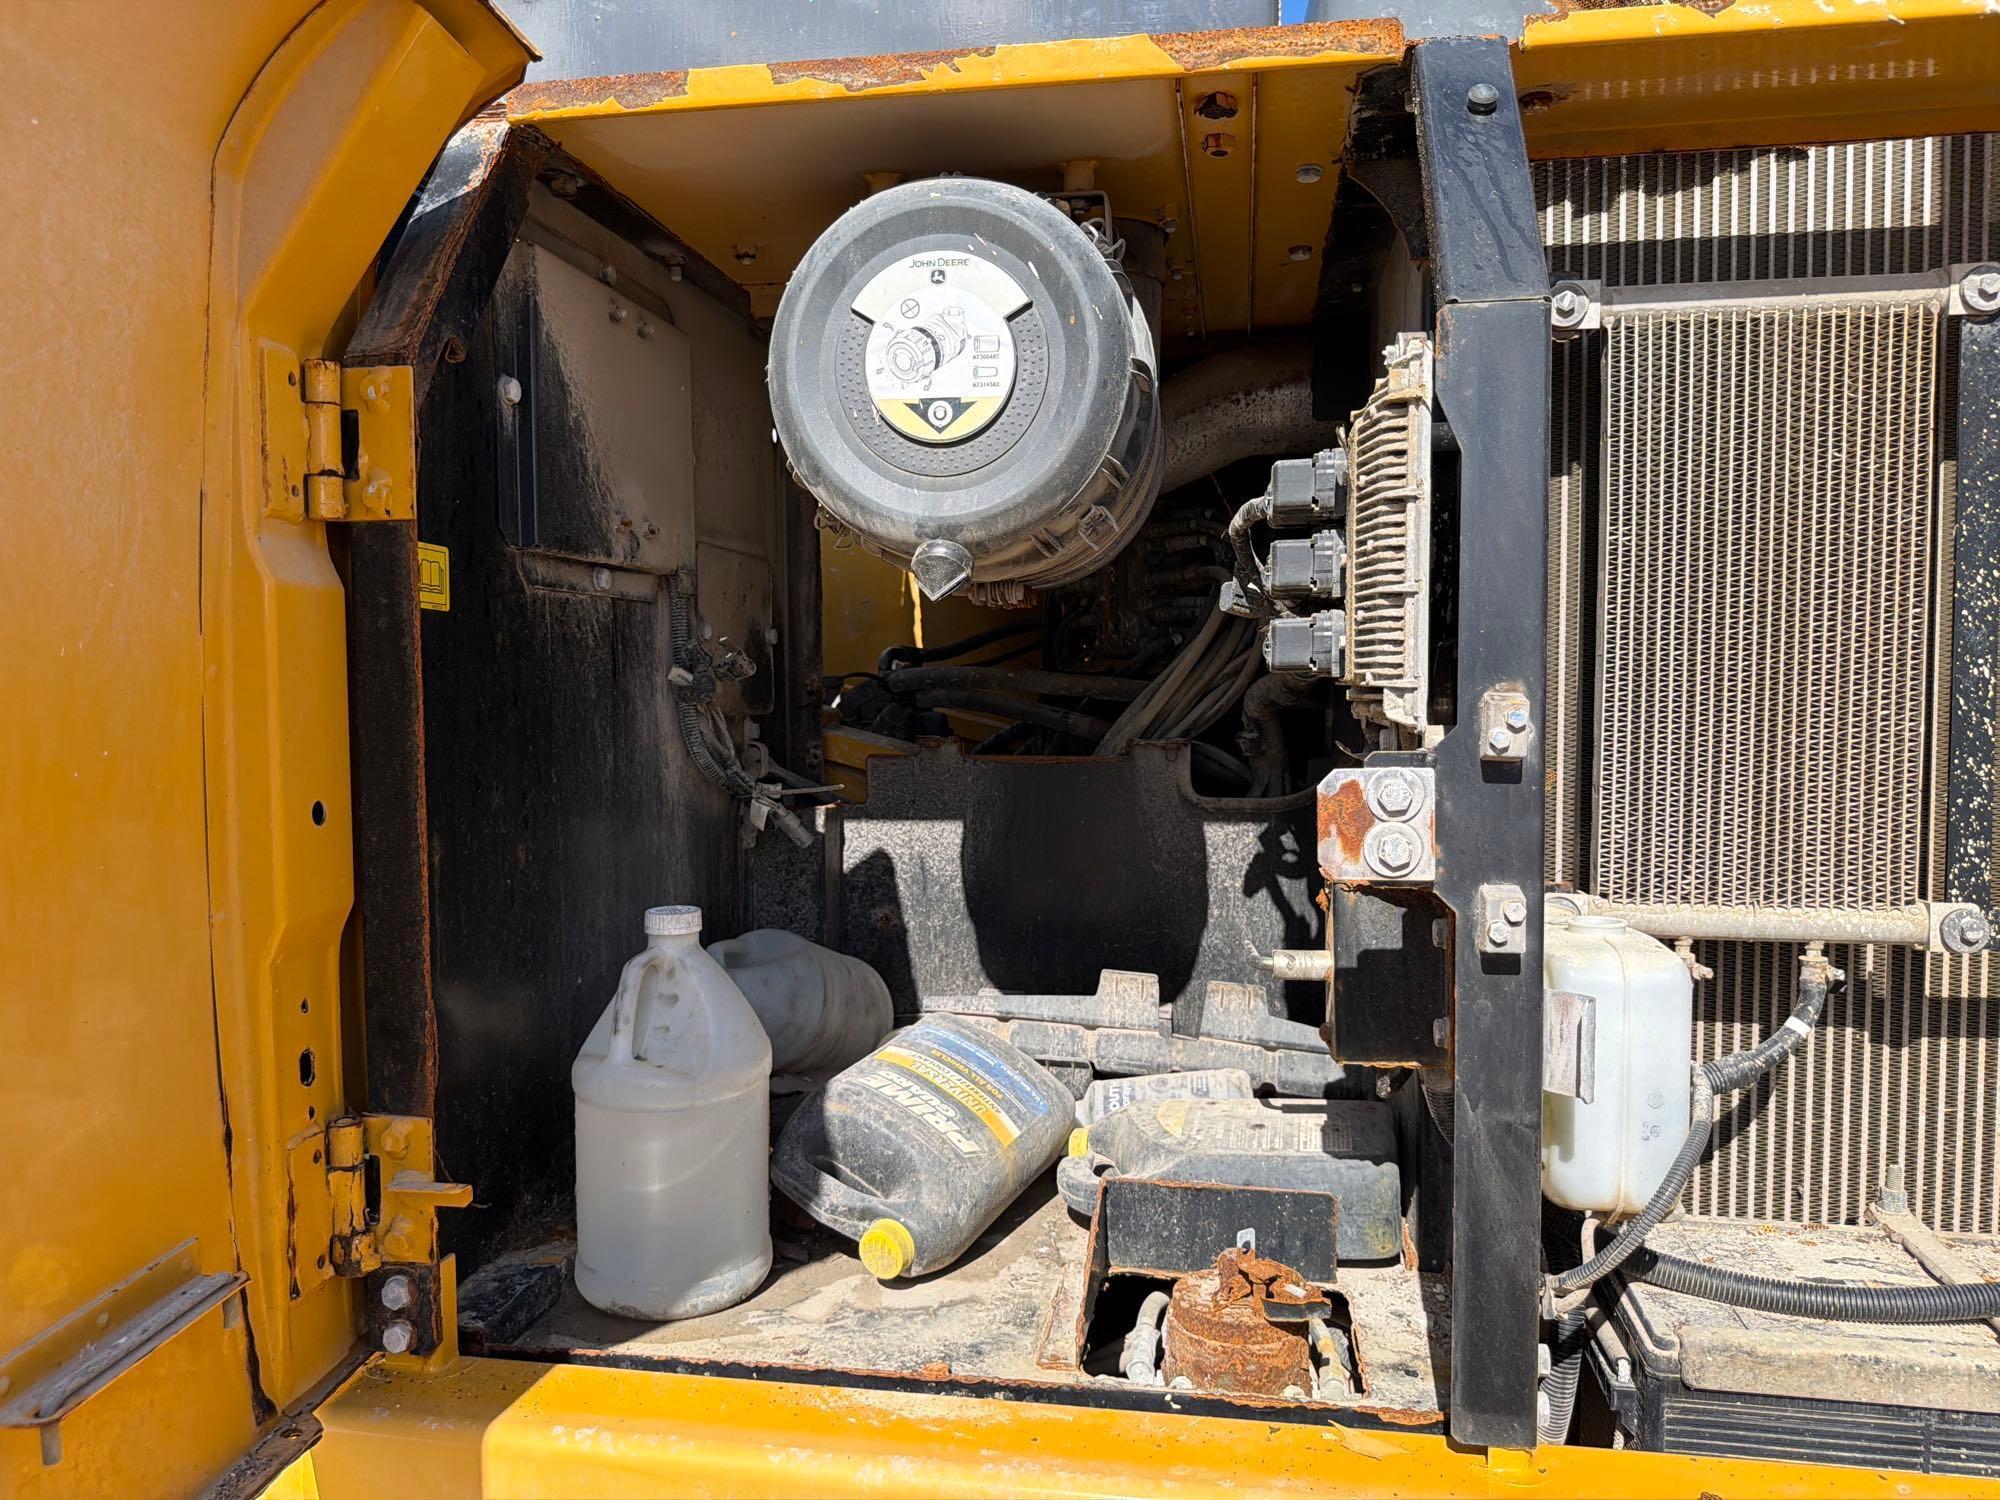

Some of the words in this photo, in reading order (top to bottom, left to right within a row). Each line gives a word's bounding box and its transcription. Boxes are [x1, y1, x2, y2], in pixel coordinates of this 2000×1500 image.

[909, 259, 936, 268] JOHN
[937, 258, 970, 267] DEERE
[929, 1048, 970, 1074] VEHICLES
[876, 1069, 958, 1118] GUARD
[911, 1060, 988, 1113] UNIVERSAL
[855, 1074, 981, 1154] PRIME
